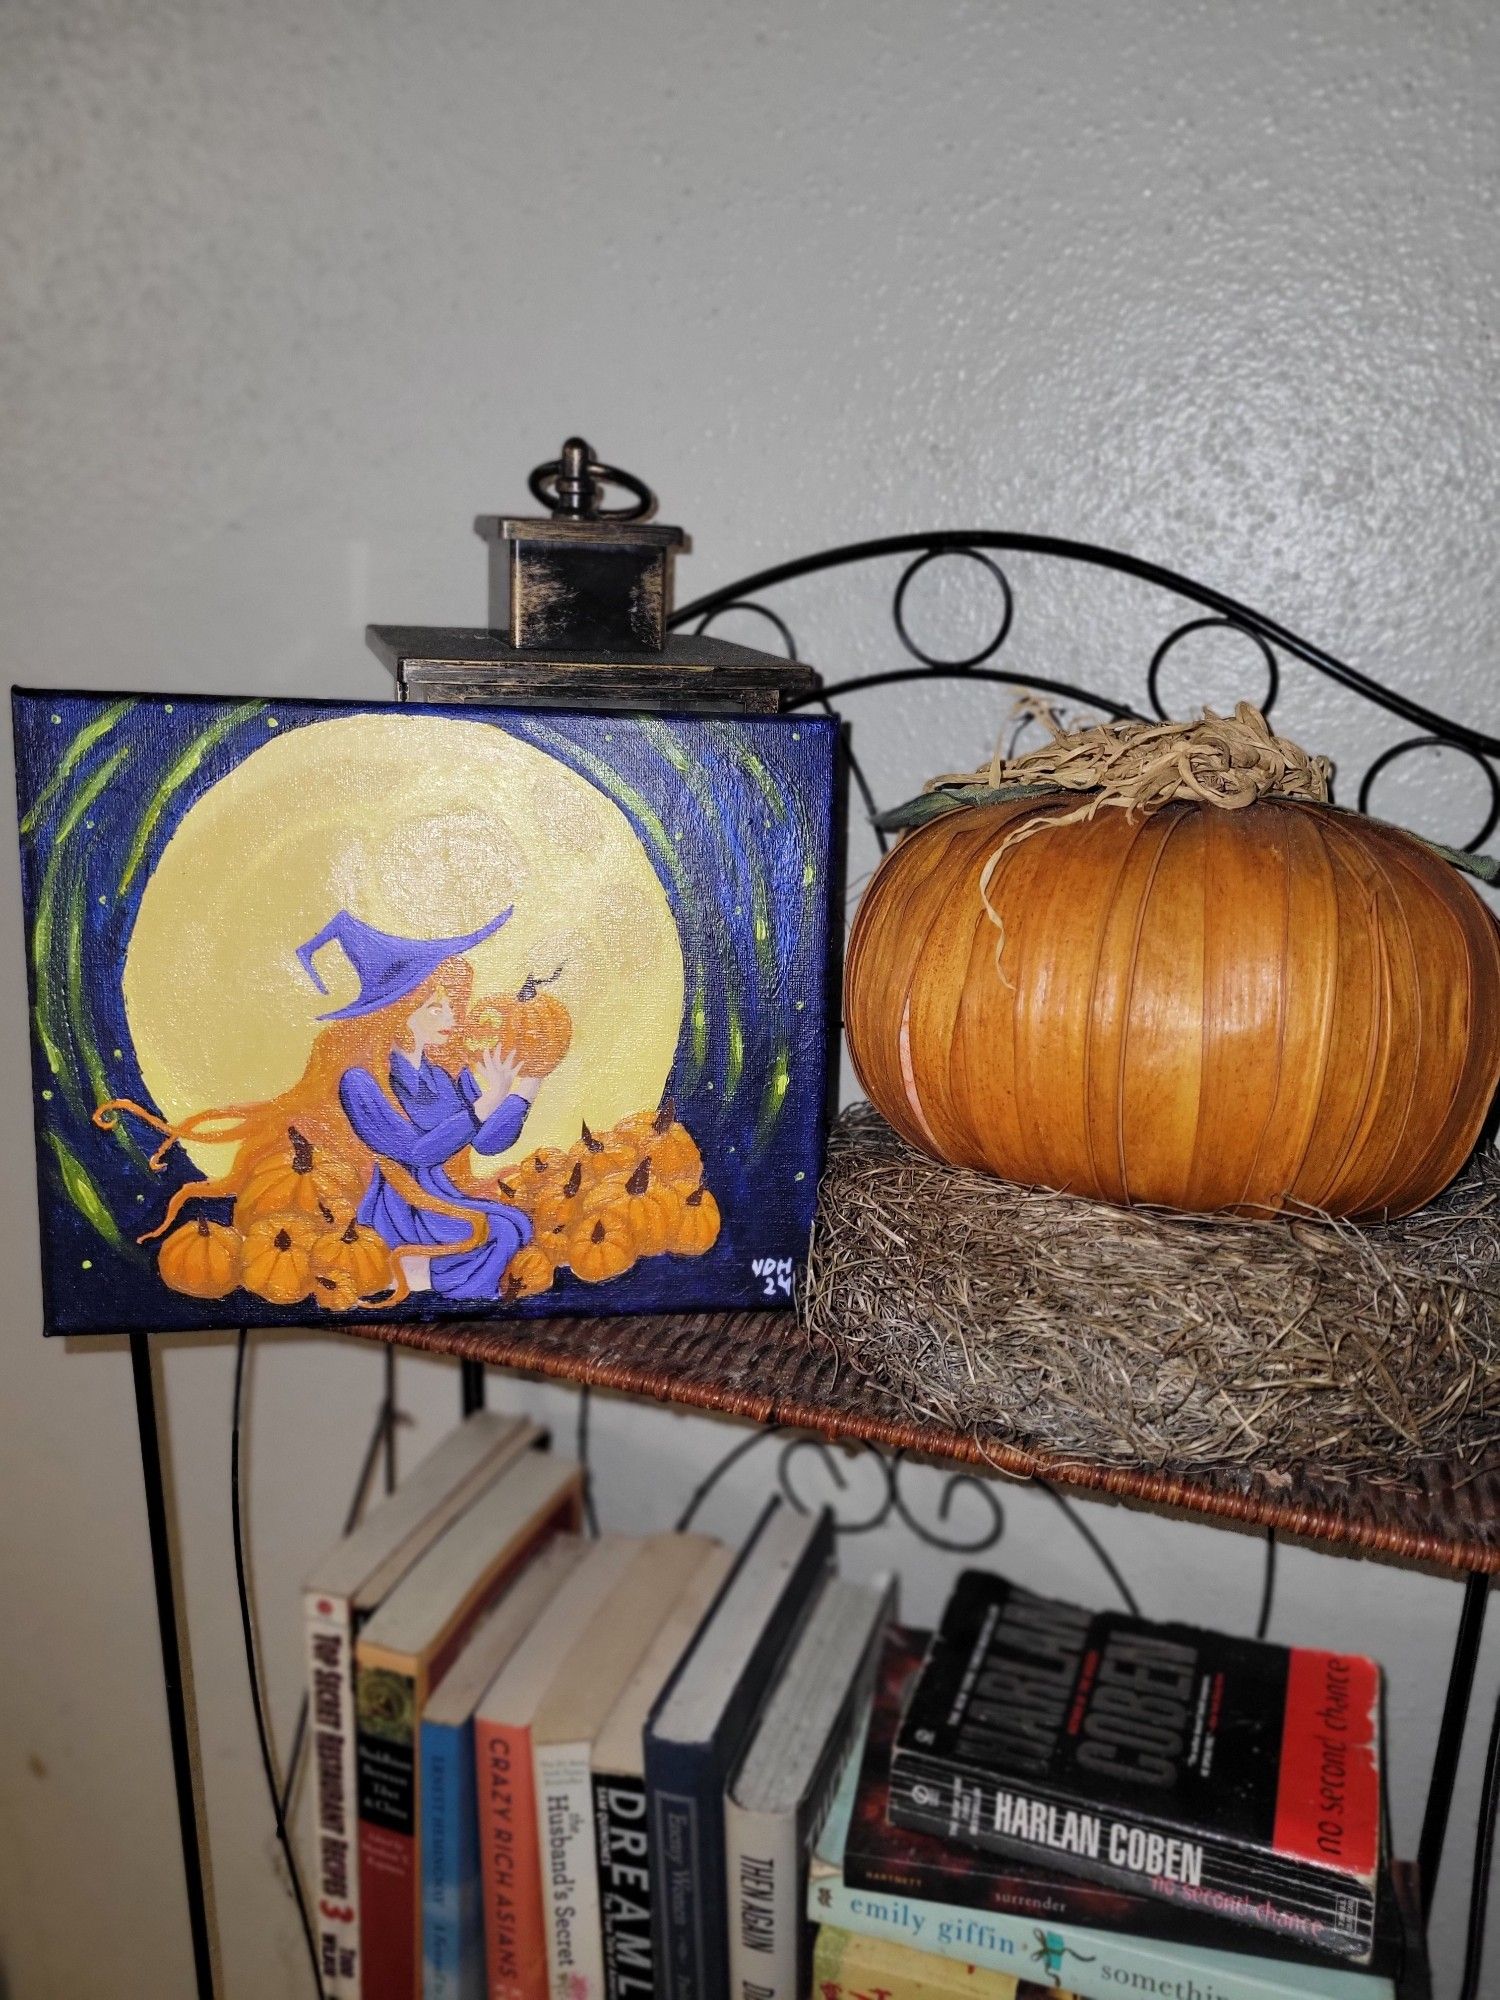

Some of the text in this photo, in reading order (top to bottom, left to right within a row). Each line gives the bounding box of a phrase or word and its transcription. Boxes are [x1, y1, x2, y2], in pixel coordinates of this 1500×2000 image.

[752, 1257, 792, 1278] VDH
[1076, 1629, 1198, 1786] COBEN
[489, 1737, 513, 1819] CRAZY
[1313, 1657, 1352, 1857] no second chance
[493, 1827, 515, 1886] RICH
[549, 1795, 576, 1901] Husband's
[994, 1791, 1100, 1859] HARLAN
[1109, 1823, 1204, 1887] COBEN
[320, 1897, 355, 1924] 3
[496, 1893, 517, 1980] ASIANS
[555, 1906, 576, 1967] Secret
[740, 1854, 775, 1955] THEN AGAIN
[850, 1898, 1015, 1955] emily giffin
[994, 1891, 1067, 1913] surrender
[1256, 1898, 1327, 1938] chance
